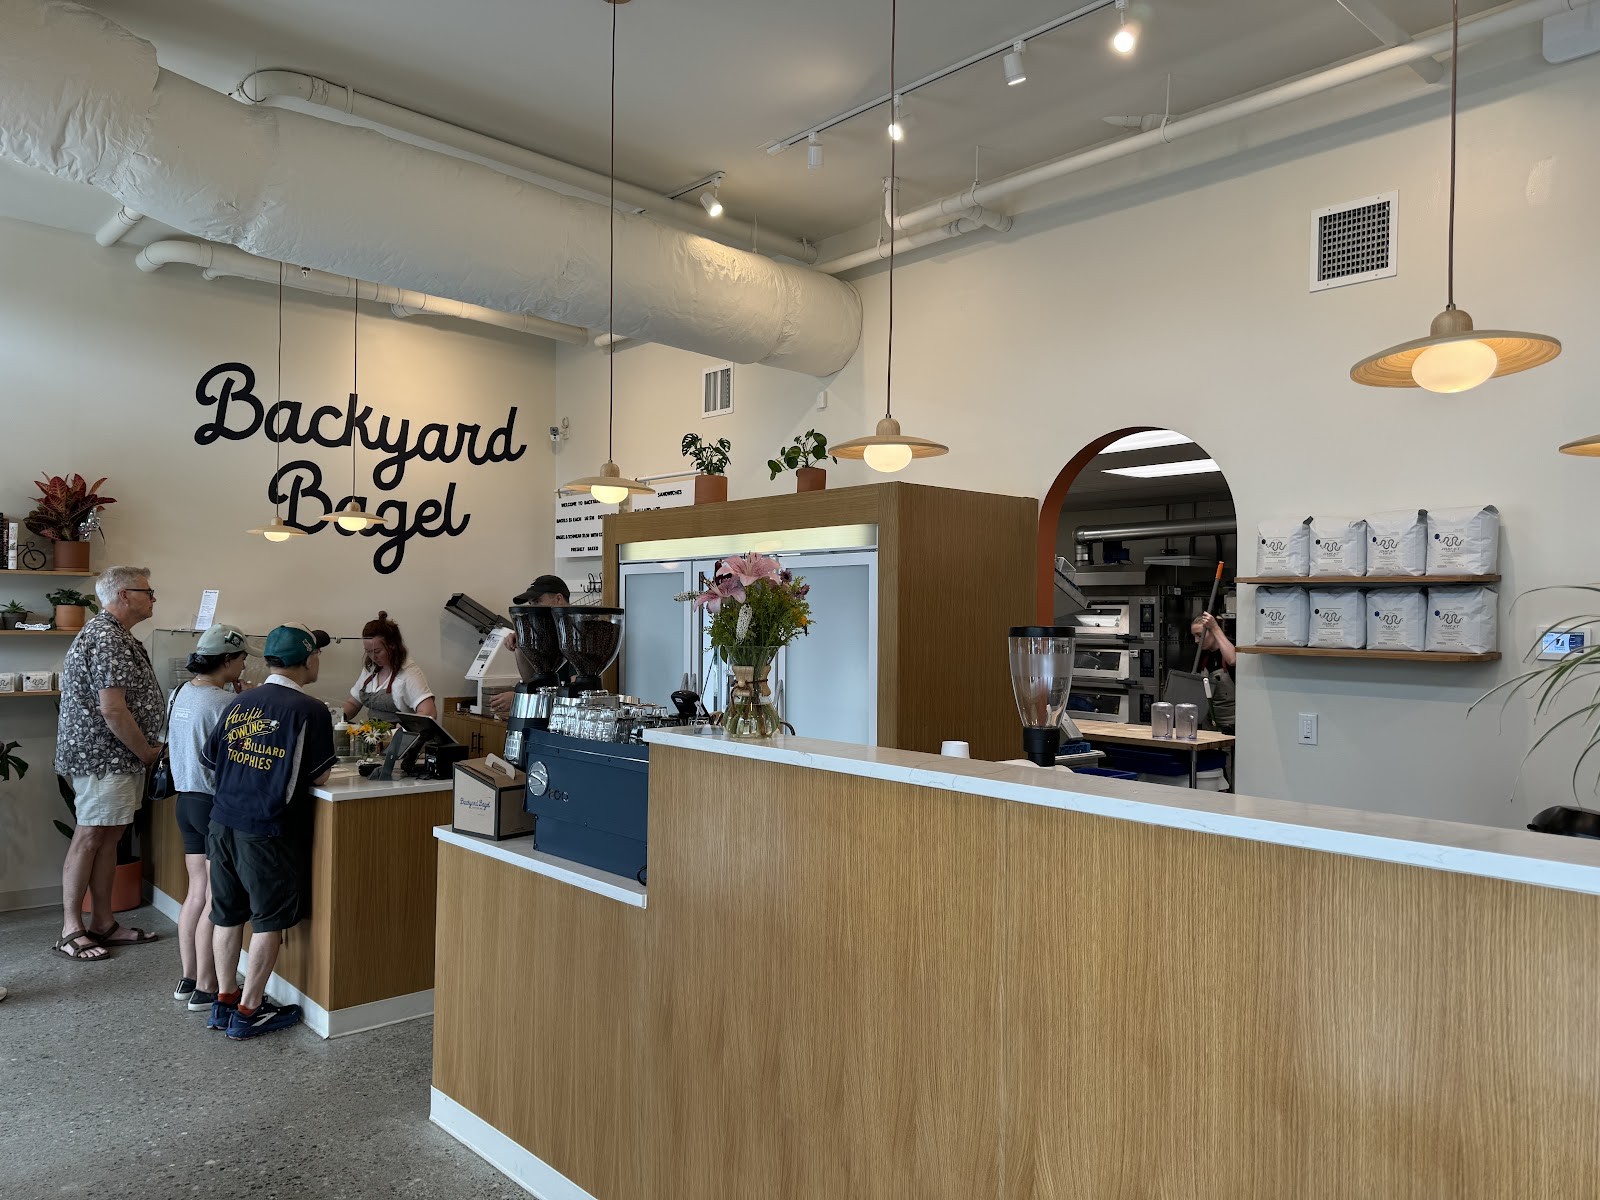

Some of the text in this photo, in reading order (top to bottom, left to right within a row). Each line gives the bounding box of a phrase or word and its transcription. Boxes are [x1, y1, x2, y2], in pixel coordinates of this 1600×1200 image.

[194, 362, 527, 491] Backyard
[657, 489, 682, 498] SANDWICHES
[268, 460, 471, 574] Bagel
[224, 703, 264, 731] Pacific
[228, 720, 265, 744] BOWLING
[227, 748, 273, 770] TROPHIES
[245, 738, 286, 758] BILLIARD
